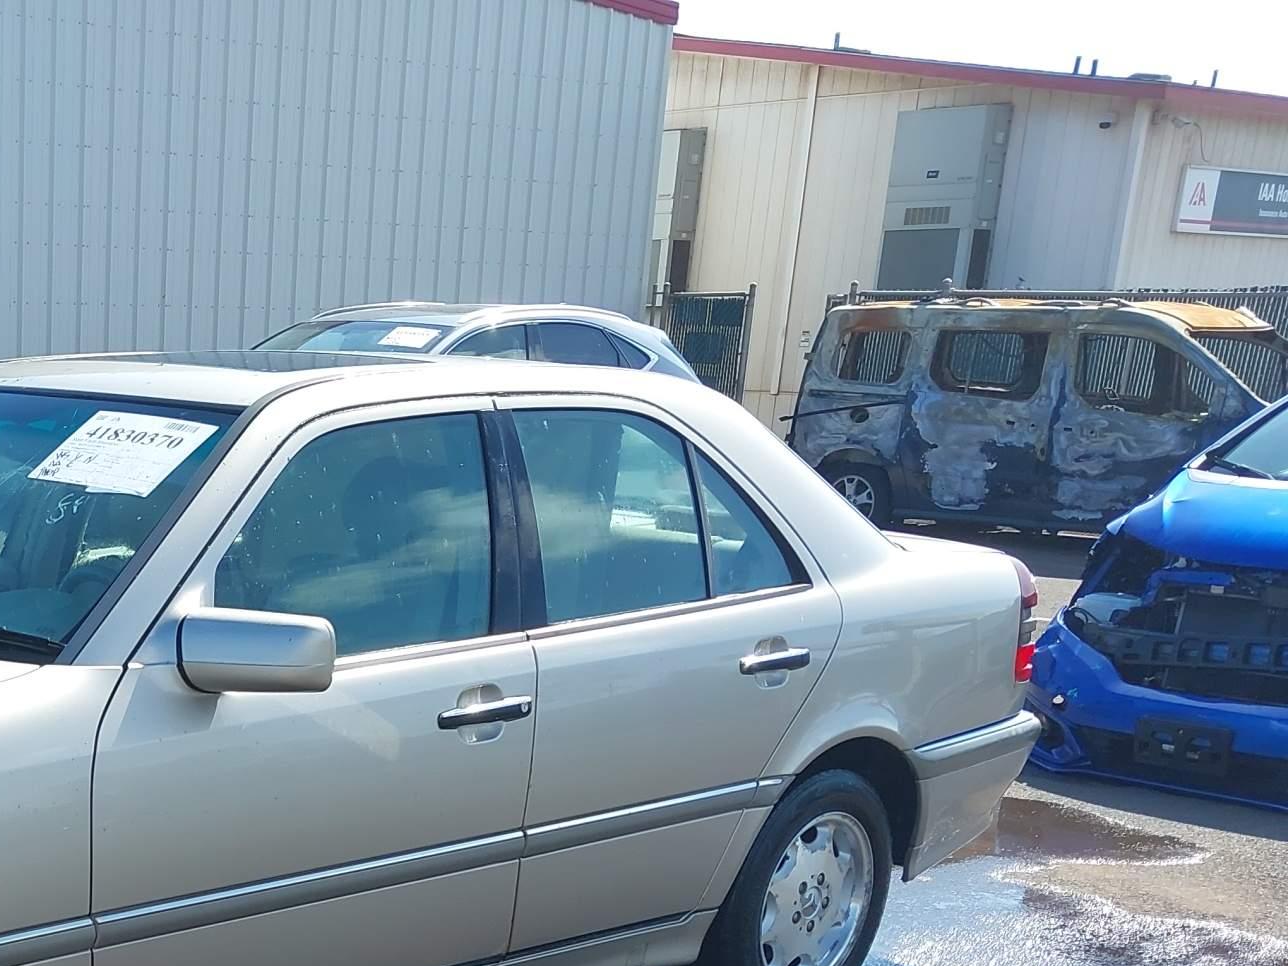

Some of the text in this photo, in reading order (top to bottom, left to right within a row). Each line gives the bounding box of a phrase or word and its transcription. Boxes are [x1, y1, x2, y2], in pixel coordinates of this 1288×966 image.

[1258, 182, 1288, 202] IAA Ho
[86, 425, 184, 449] 41830370
